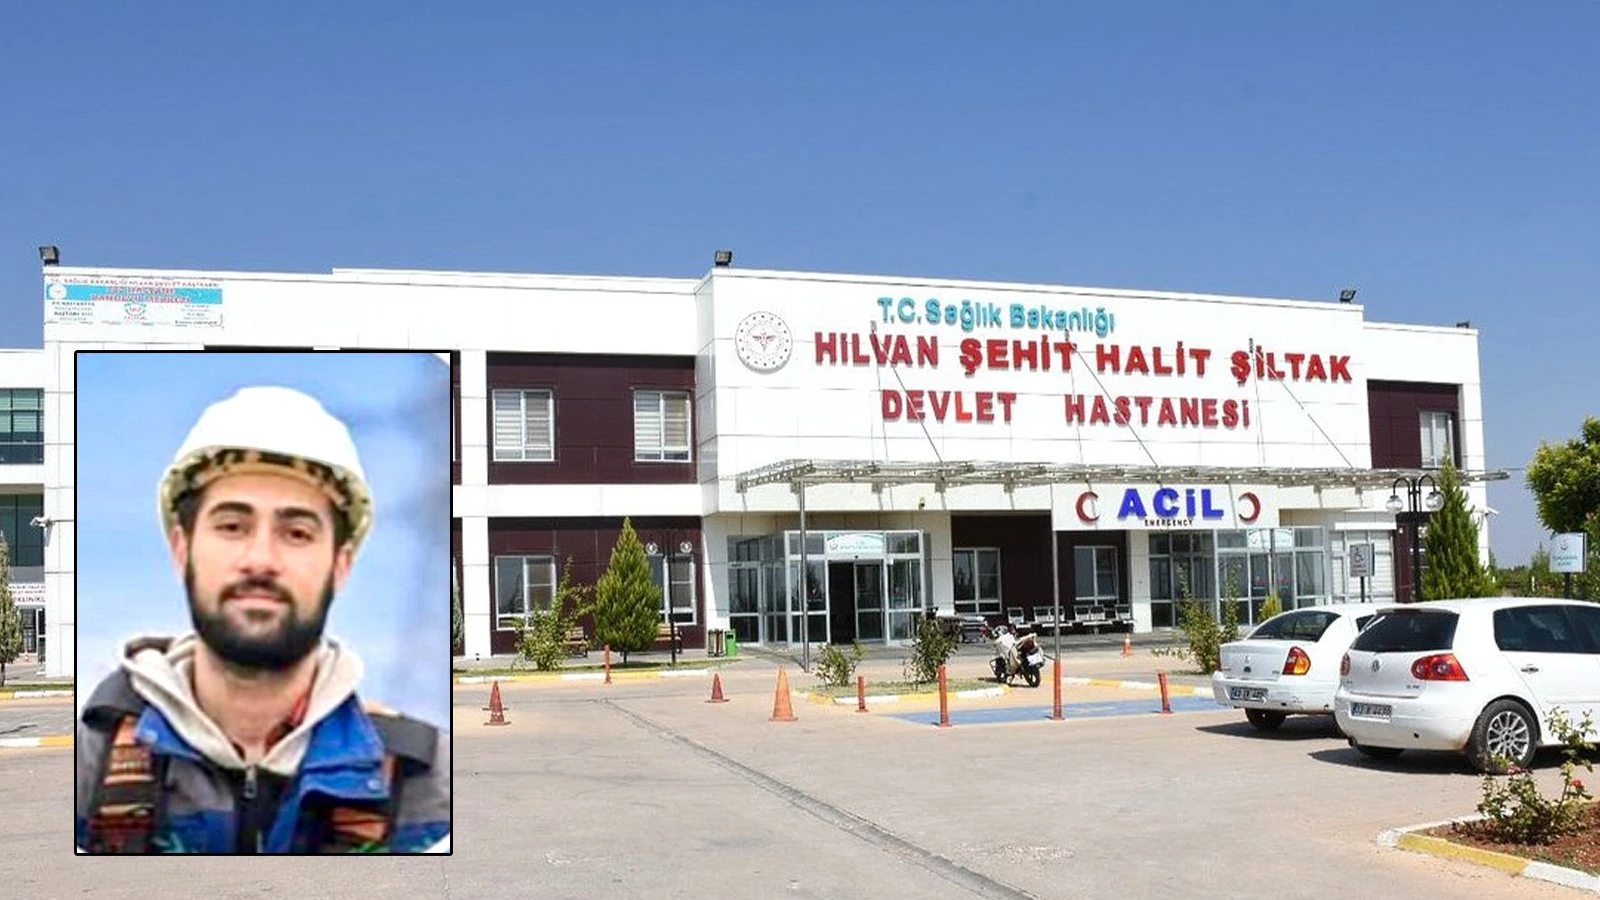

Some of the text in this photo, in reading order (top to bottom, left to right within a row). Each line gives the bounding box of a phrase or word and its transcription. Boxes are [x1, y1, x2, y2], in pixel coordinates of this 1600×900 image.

[924, 298, 1002, 332] Sağlık
[1009, 303, 1115, 338] Bakanlığı
[960, 334, 1077, 377] ŞEHİT
[1096, 341, 1211, 378] HALİT
[1230, 345, 1352, 386] ŞİLTAK
[882, 389, 1017, 424] DEVLET
[1144, 519, 1192, 527] EMERGENCY
